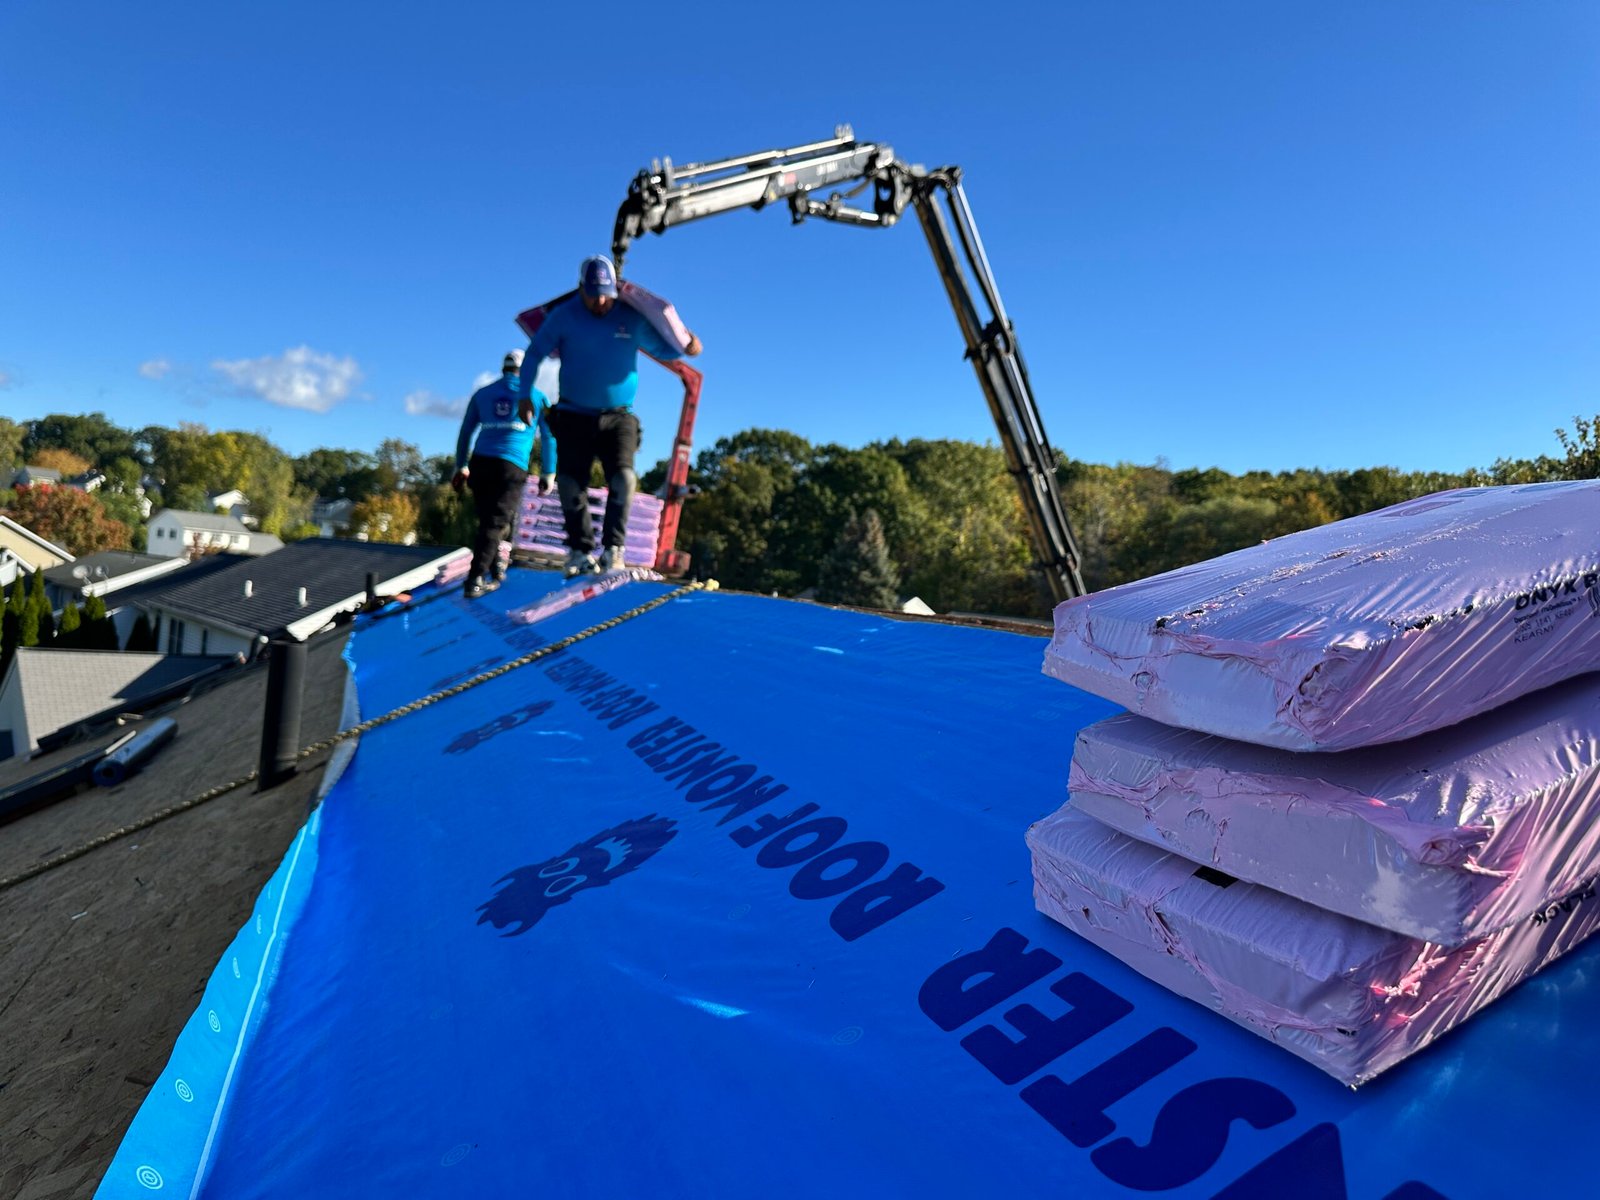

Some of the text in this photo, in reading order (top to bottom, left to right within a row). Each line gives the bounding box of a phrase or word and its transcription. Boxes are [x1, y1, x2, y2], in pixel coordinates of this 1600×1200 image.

[1514, 577, 1577, 611] ONYX
[579, 683, 661, 731] ROOF
[626, 715, 946, 942] ROOF MONSTER
